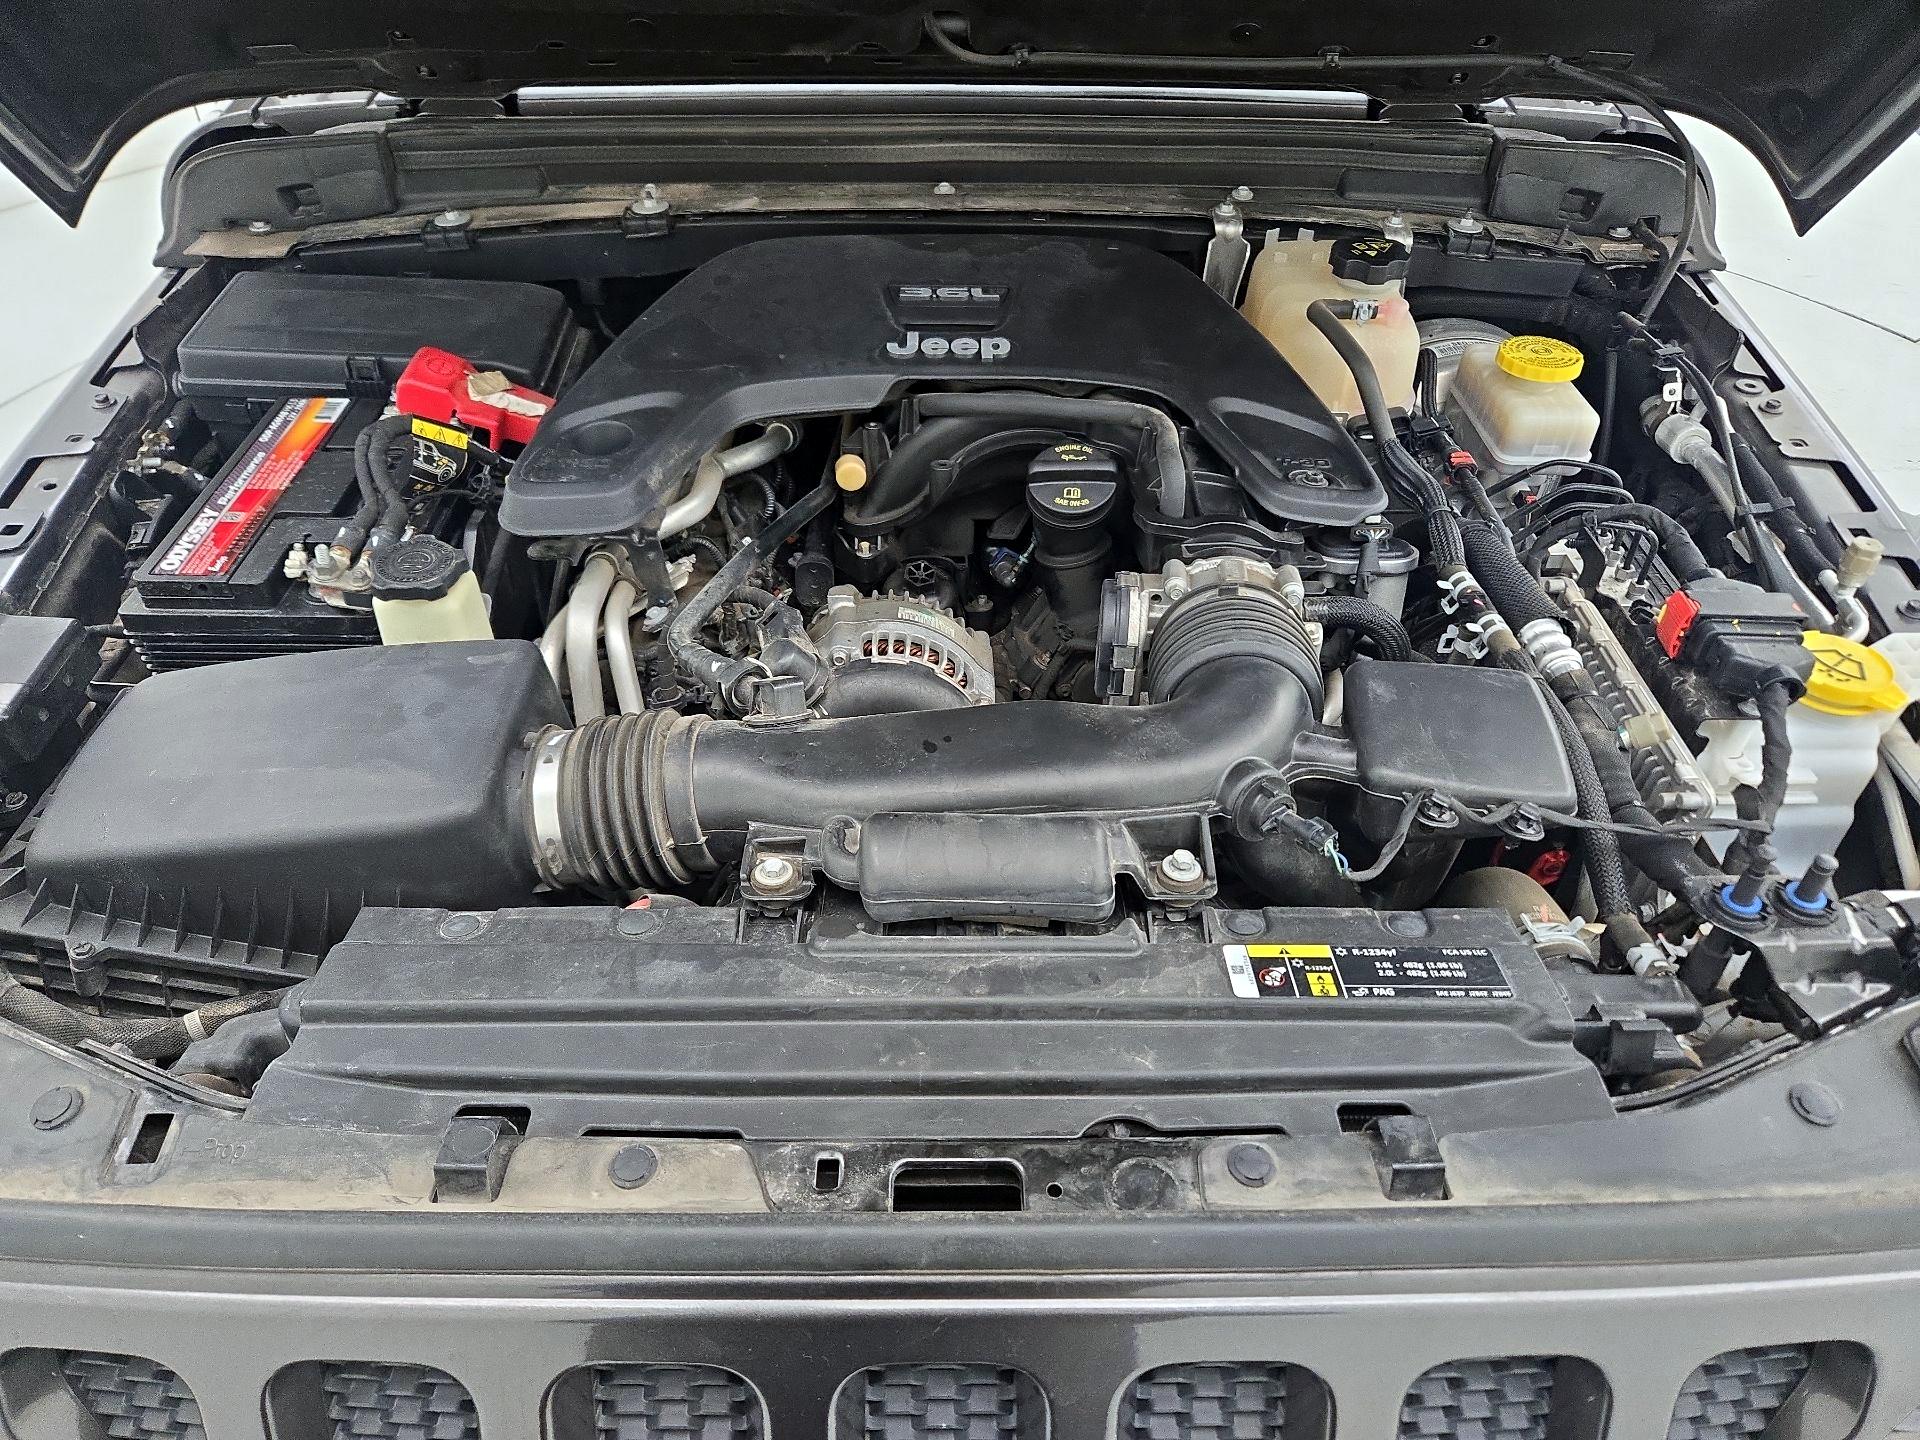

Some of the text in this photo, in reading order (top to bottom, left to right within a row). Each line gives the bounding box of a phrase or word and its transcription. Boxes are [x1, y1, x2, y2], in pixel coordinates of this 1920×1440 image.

[899, 287, 1000, 301] 3.6L
[886, 331, 1011, 362] Jeep
[1054, 444, 1094, 454] ENGINE OIL
[217, 451, 266, 505] Performance
[1054, 497, 1090, 507] SAE 0W-20
[159, 505, 221, 571] ODYSSEY
[1351, 948, 1397, 957] R-1234yf
[1441, 948, 1460, 956] FCA
[1372, 987, 1396, 997] PAG
